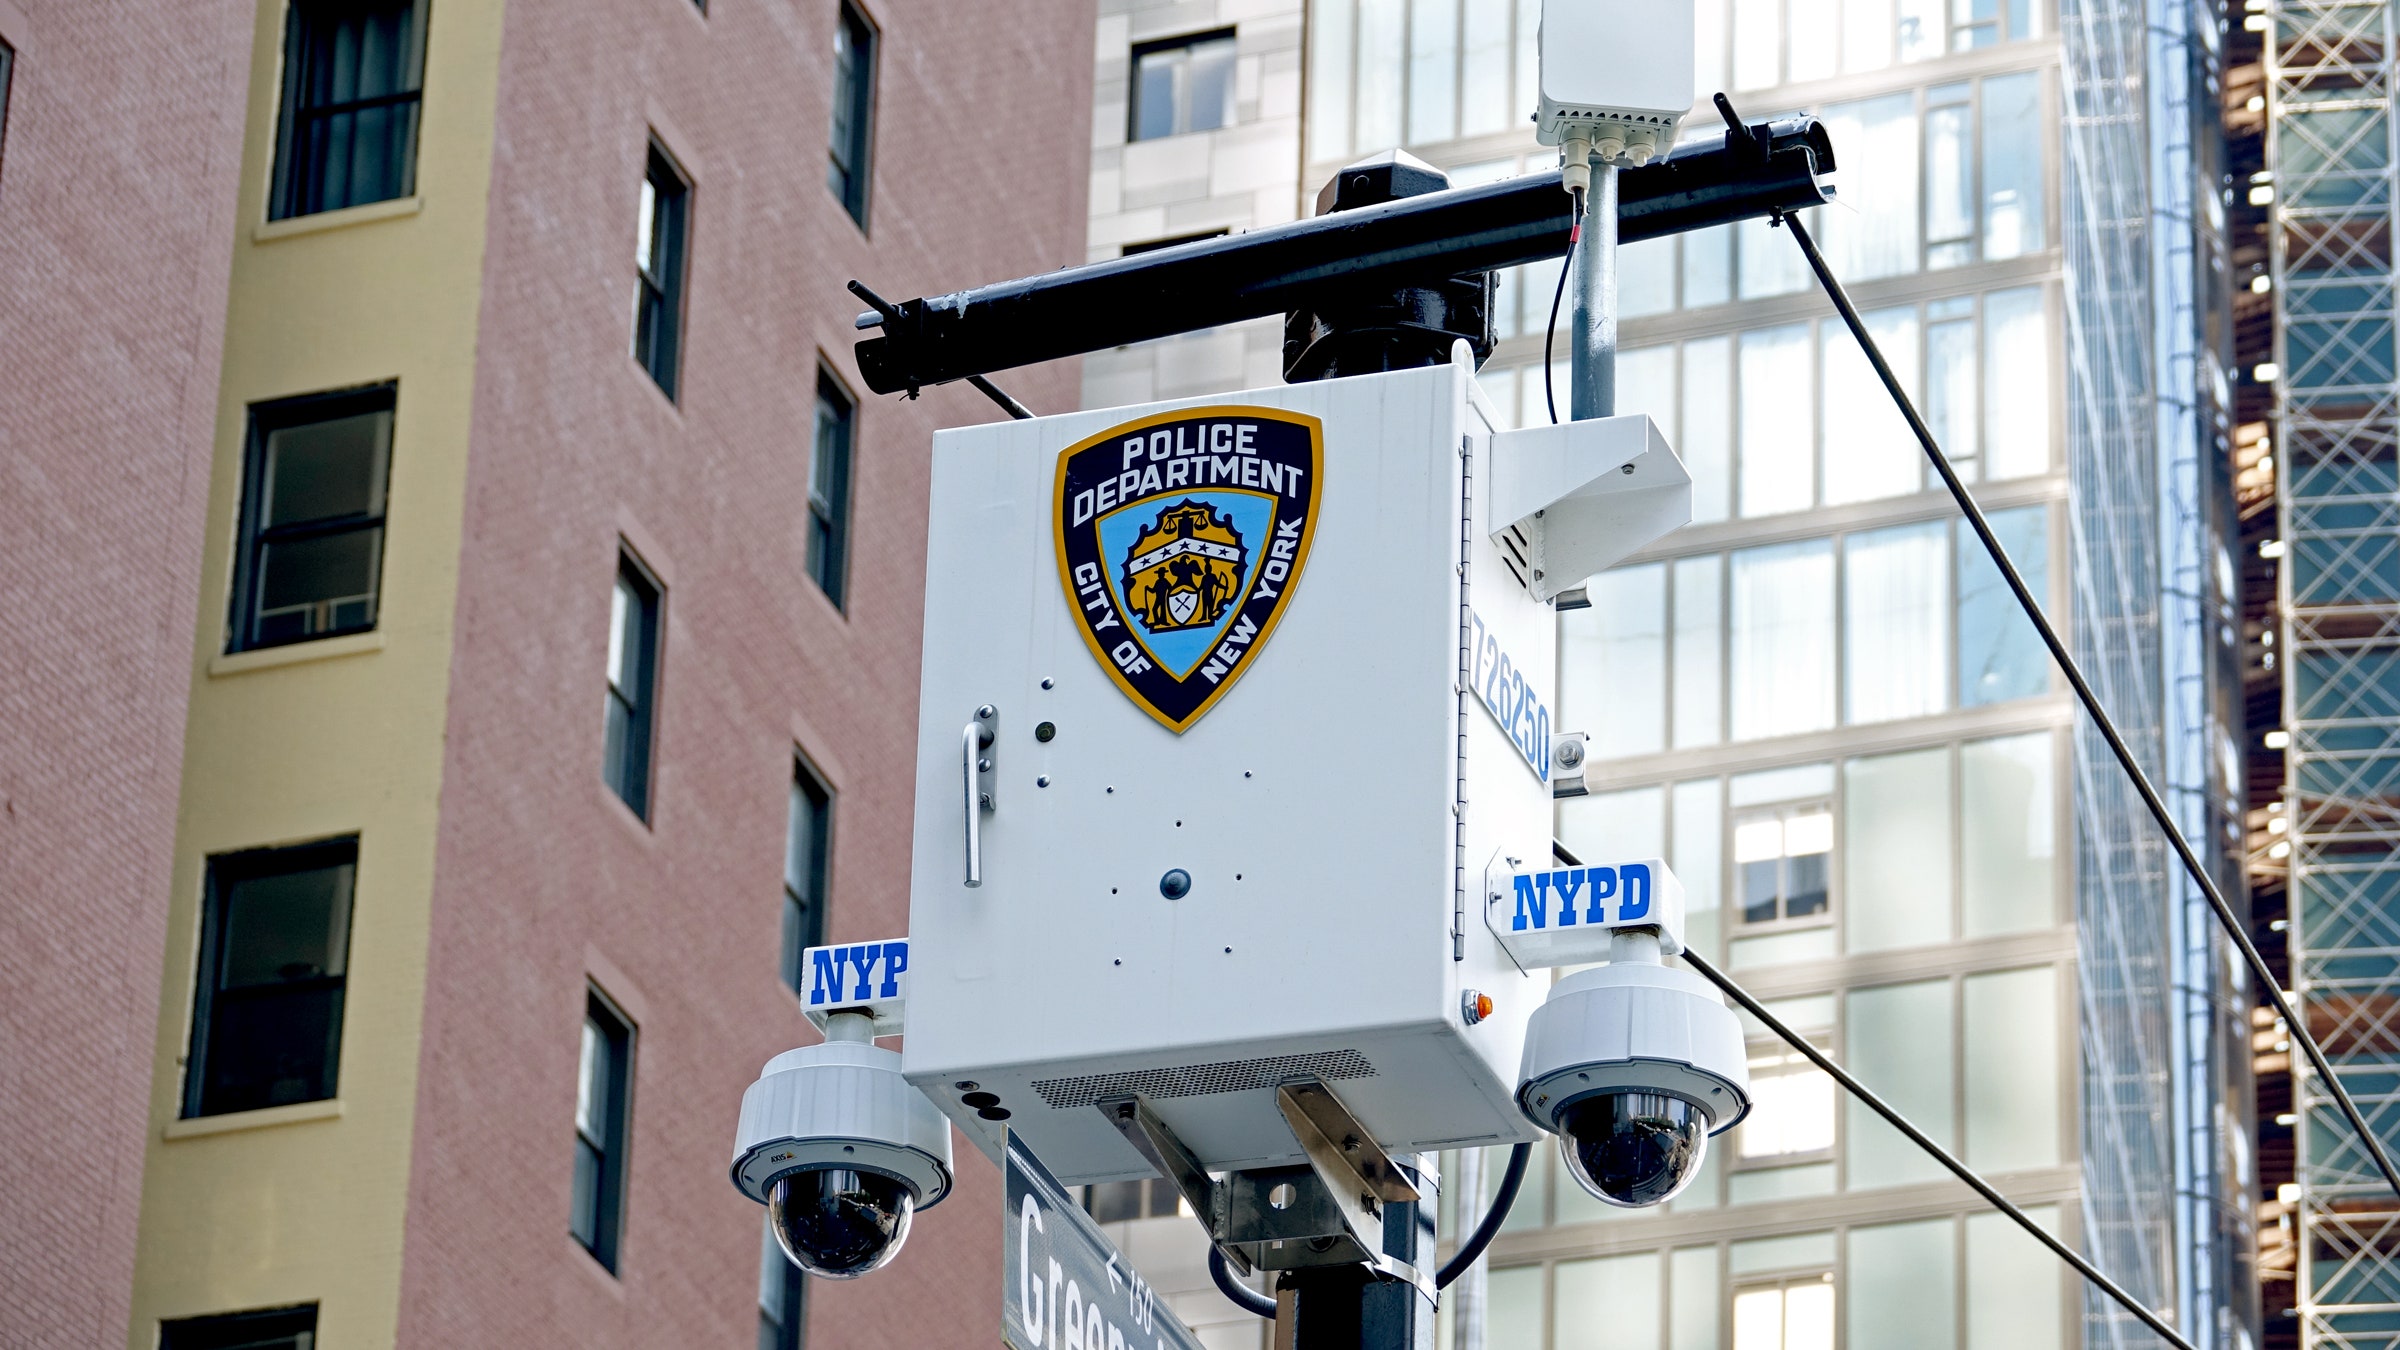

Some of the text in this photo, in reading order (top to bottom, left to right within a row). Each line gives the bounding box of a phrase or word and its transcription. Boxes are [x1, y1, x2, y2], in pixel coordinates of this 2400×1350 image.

[1123, 424, 1258, 471] POLICE
[1073, 455, 1304, 528] DEPARTMENT
[1075, 561, 1152, 676] CITY OF
[1200, 516, 1303, 684] NEW YORK
[1473, 611, 1549, 782] 7-26250
[1512, 863, 1651, 932] NYPD
[770, 1153, 787, 1163] AXIS
[1129, 1270, 1153, 1335] 150
